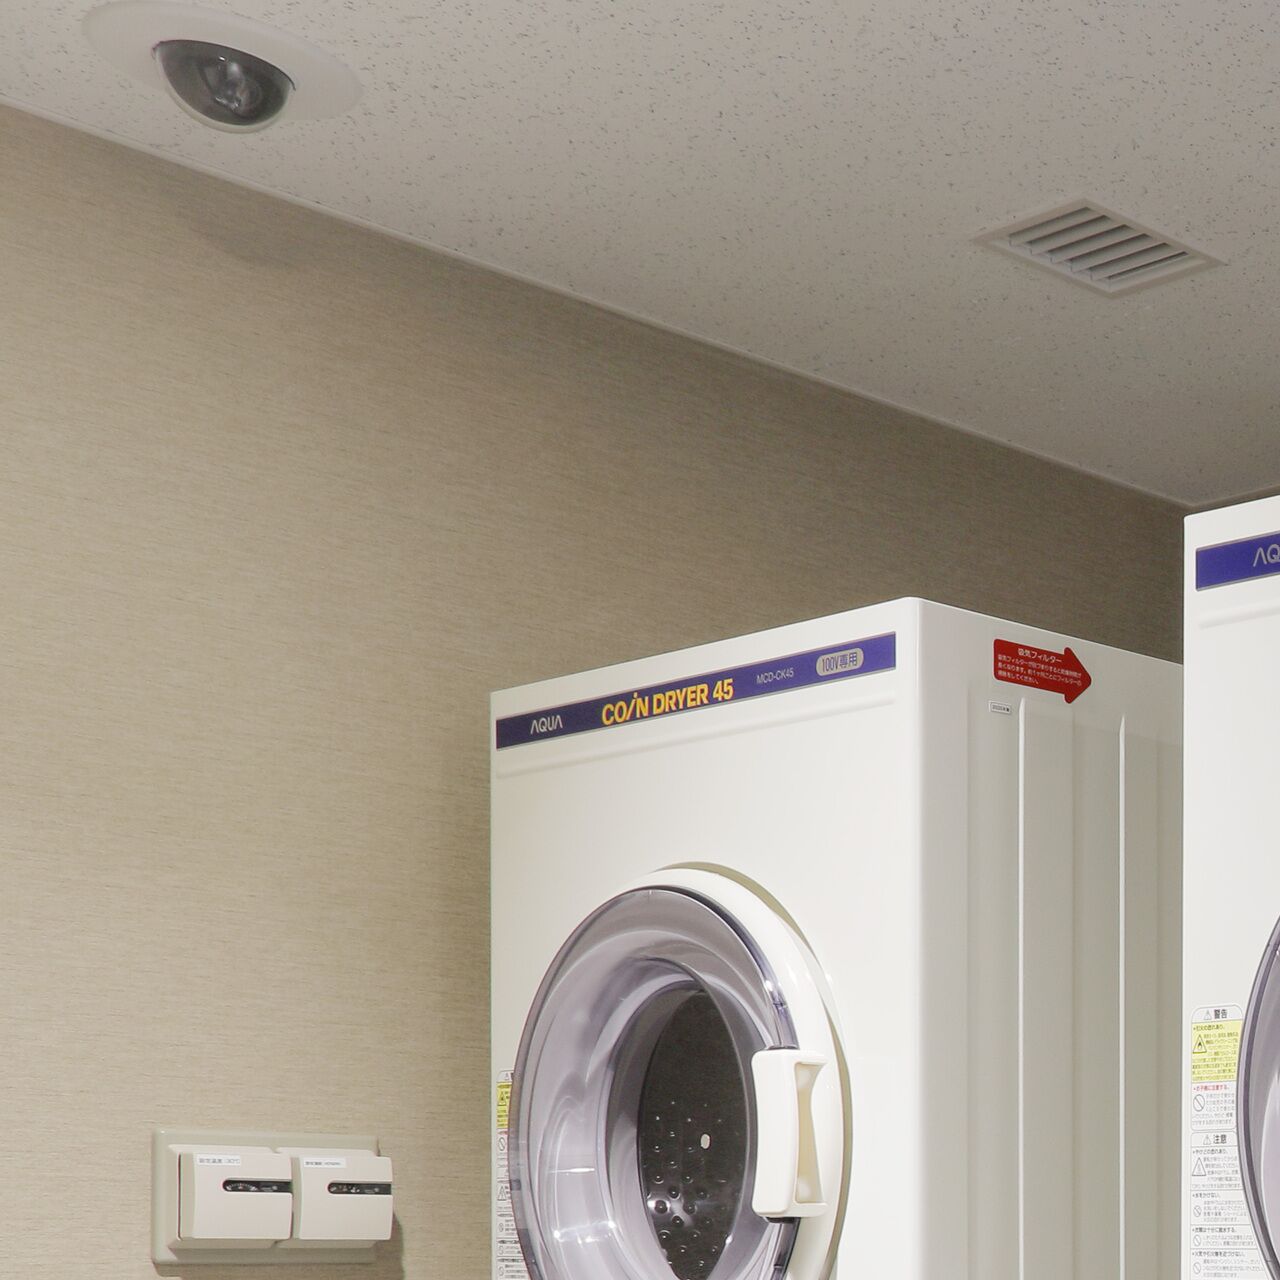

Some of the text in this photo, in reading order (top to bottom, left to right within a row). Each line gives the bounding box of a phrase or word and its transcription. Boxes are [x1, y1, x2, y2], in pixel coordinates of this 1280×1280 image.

[757, 667, 794, 684] MCD-CK45
[652, 684, 708, 716] DRYER
[713, 678, 733, 701] 45
[530, 715, 563, 734] AQUA
[1213, 1135, 1227, 1144] 注意
